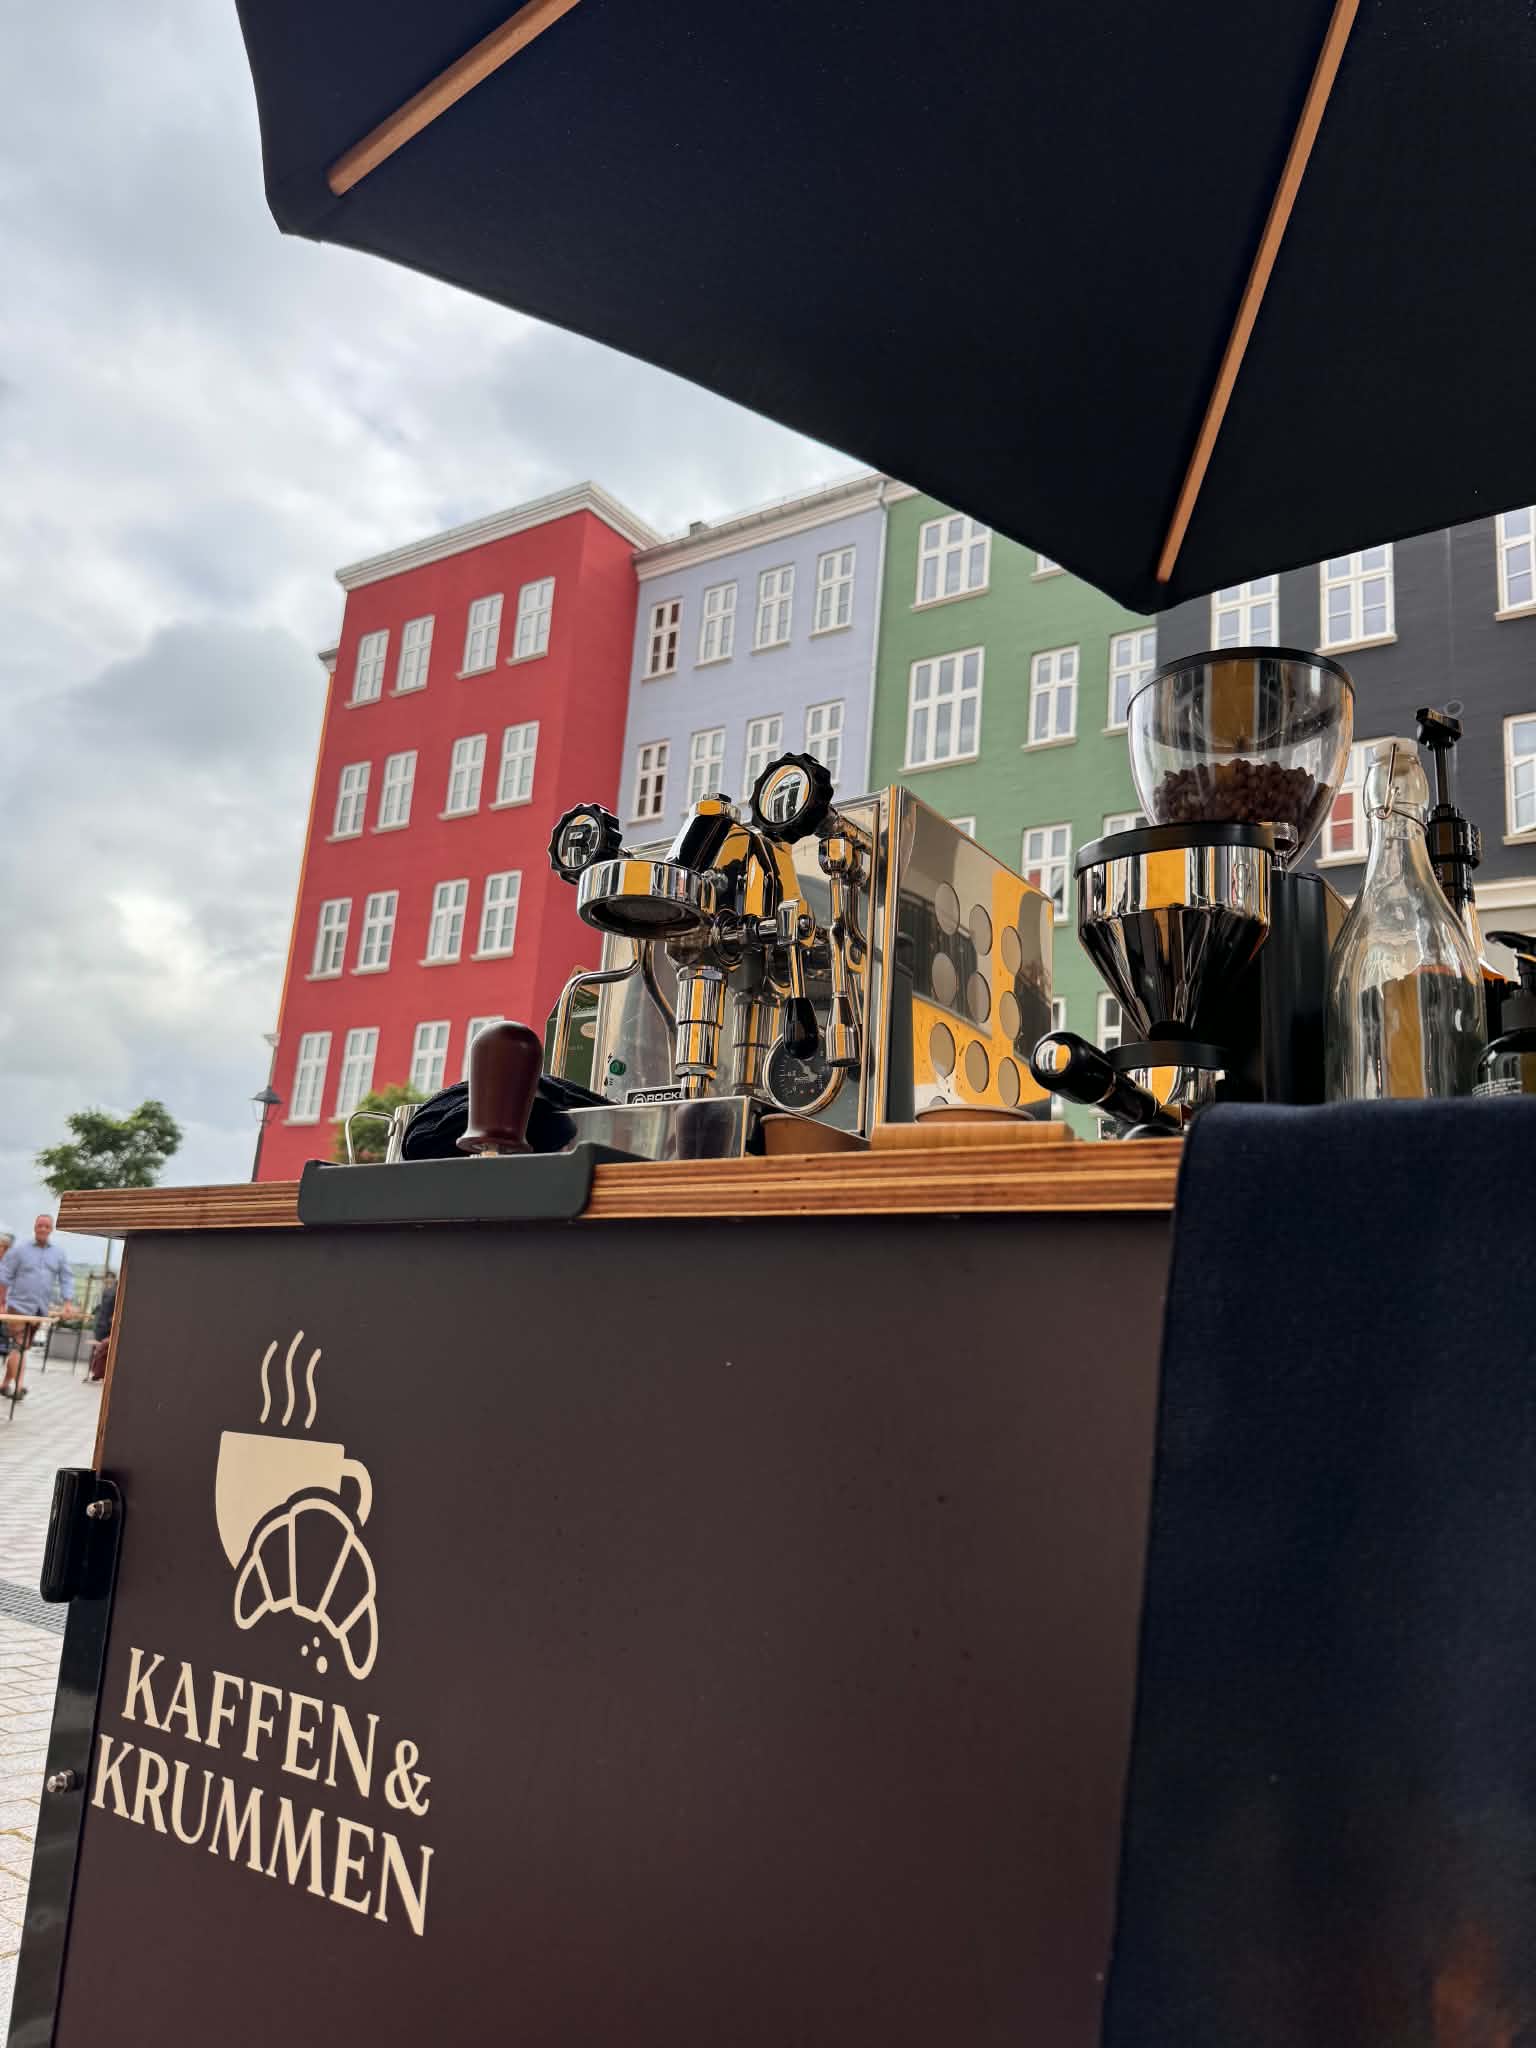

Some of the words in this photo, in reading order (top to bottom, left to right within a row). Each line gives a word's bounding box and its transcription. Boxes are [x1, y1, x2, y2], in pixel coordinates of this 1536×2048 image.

[121, 1647, 380, 1798] KAFFEN
[384, 1739, 431, 1817] &
[91, 1733, 435, 1937] KRUMMEN
